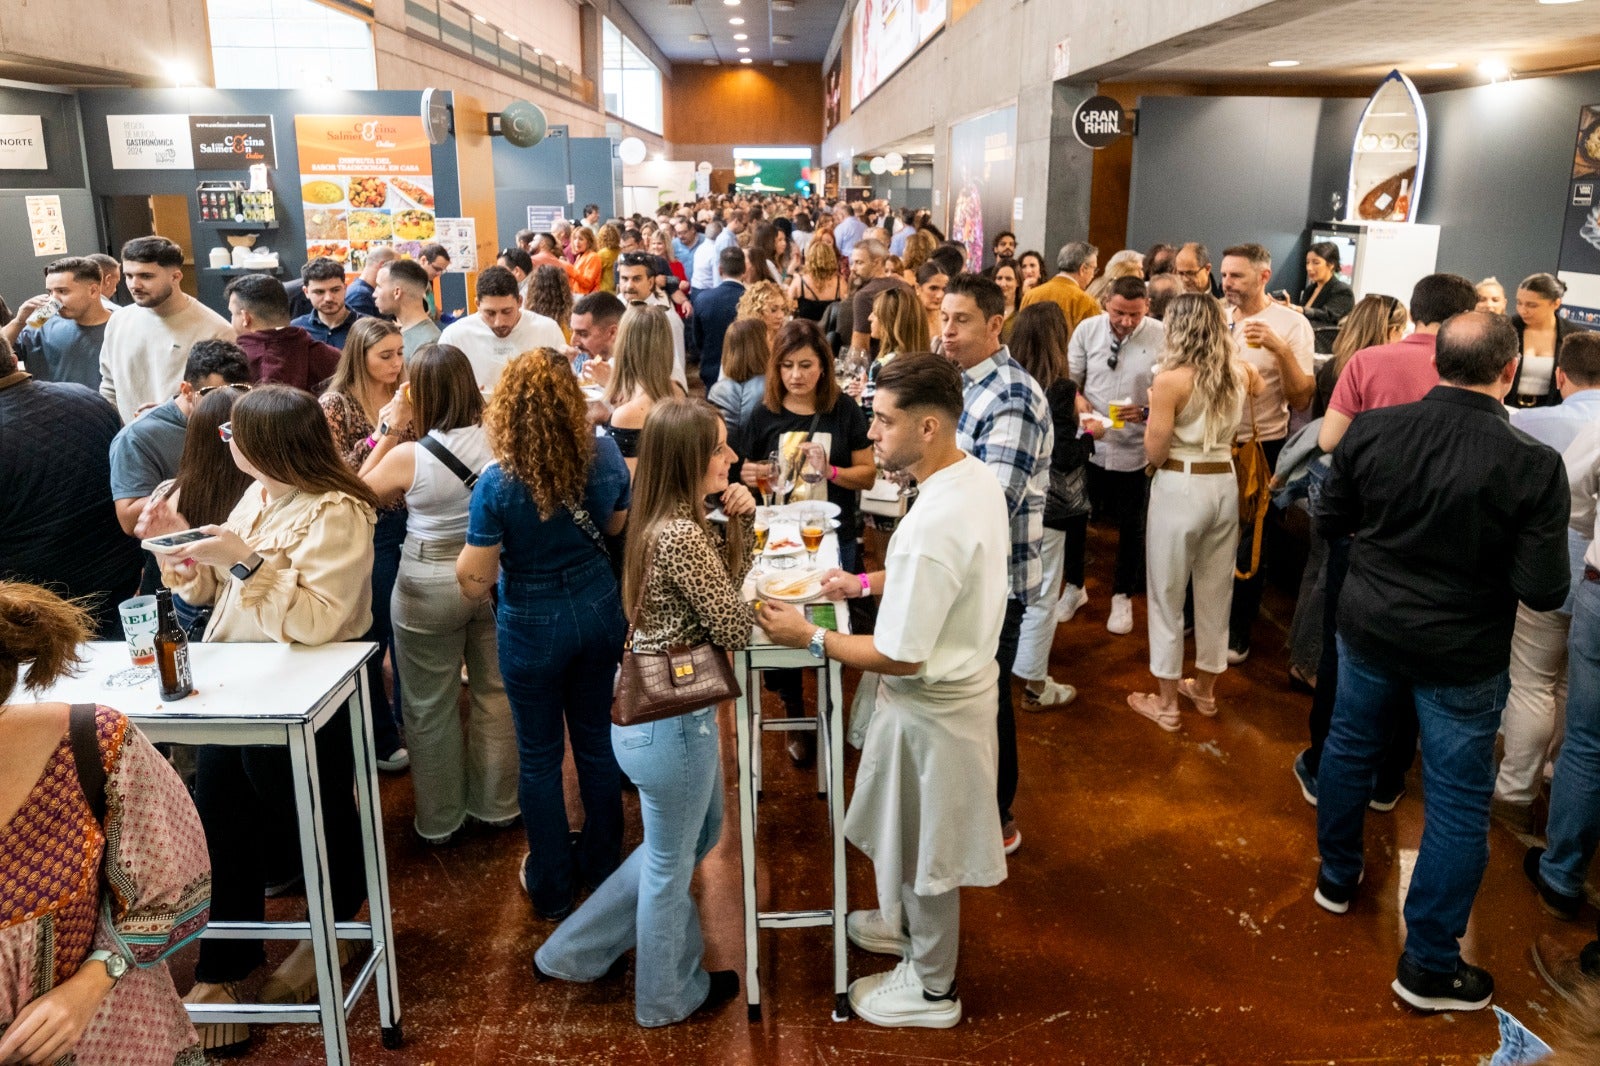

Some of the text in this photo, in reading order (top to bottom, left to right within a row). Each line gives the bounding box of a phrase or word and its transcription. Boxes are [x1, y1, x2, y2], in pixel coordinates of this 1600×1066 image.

[1080, 110, 1118, 122] GRAN
[0, 138, 33, 146] NORTE
[126, 138, 174, 146] GASTRONÓMICA
[224, 134, 265, 147] Cocina
